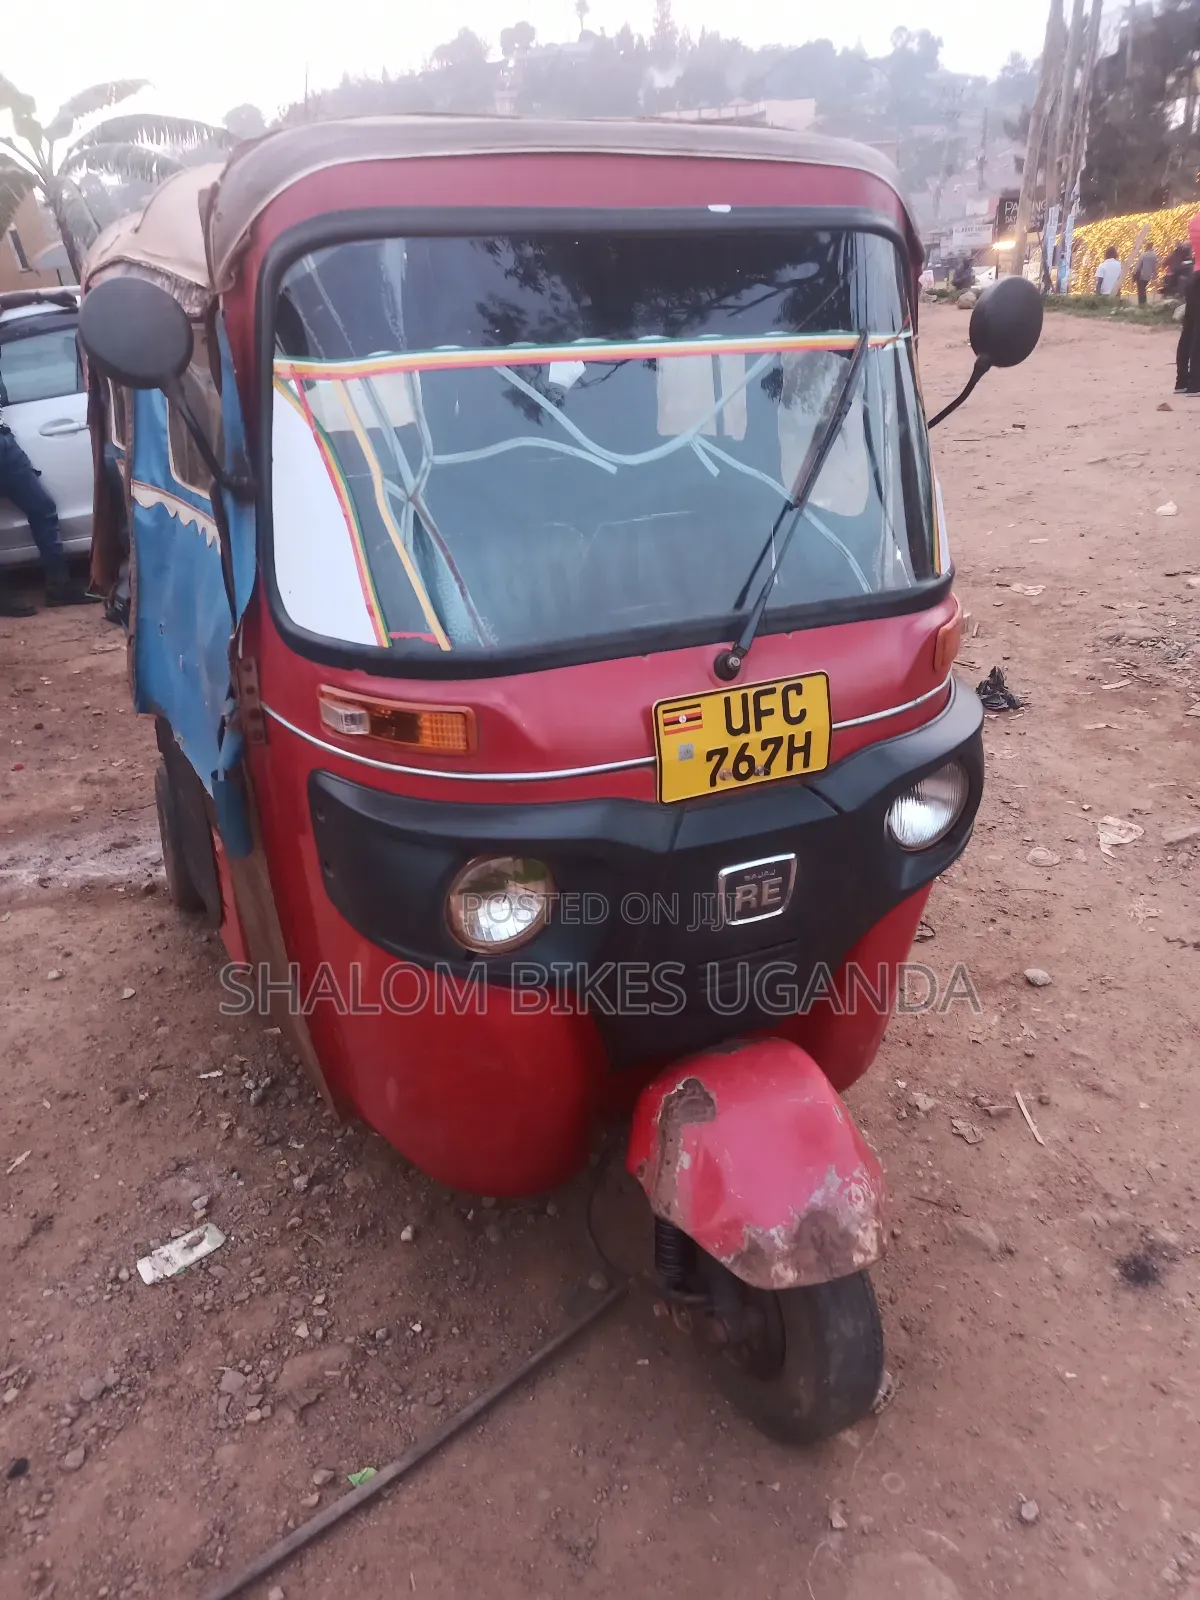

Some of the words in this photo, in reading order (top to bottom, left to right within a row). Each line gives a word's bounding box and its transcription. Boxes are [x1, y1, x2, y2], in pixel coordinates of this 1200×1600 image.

[1004, 200, 1046, 216] PAING
[724, 682, 807, 737] UFC
[705, 730, 812, 788] 767H
[735, 876, 783, 913] RE
